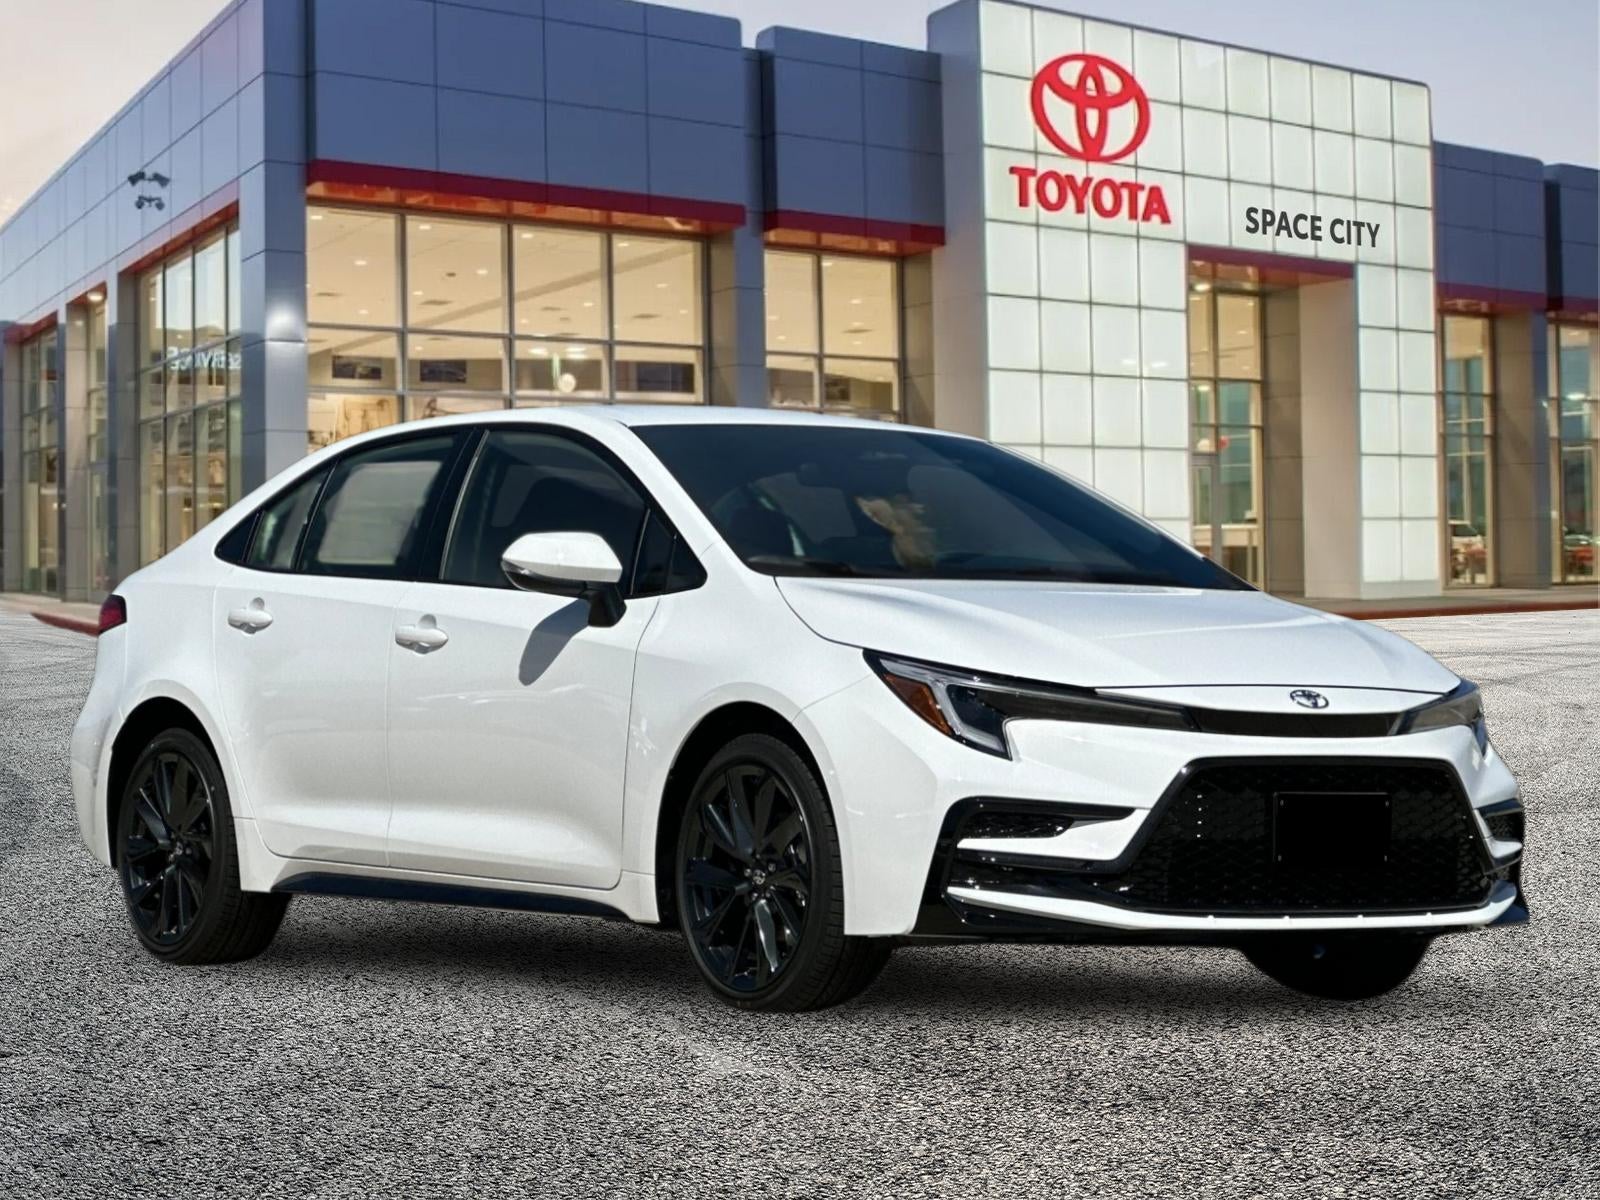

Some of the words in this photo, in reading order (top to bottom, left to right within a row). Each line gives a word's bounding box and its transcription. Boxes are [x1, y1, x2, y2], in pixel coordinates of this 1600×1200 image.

[1009, 166, 1171, 224] TOYOTA
[1245, 206, 1323, 241] SPACE
[1329, 218, 1380, 248] CITY
